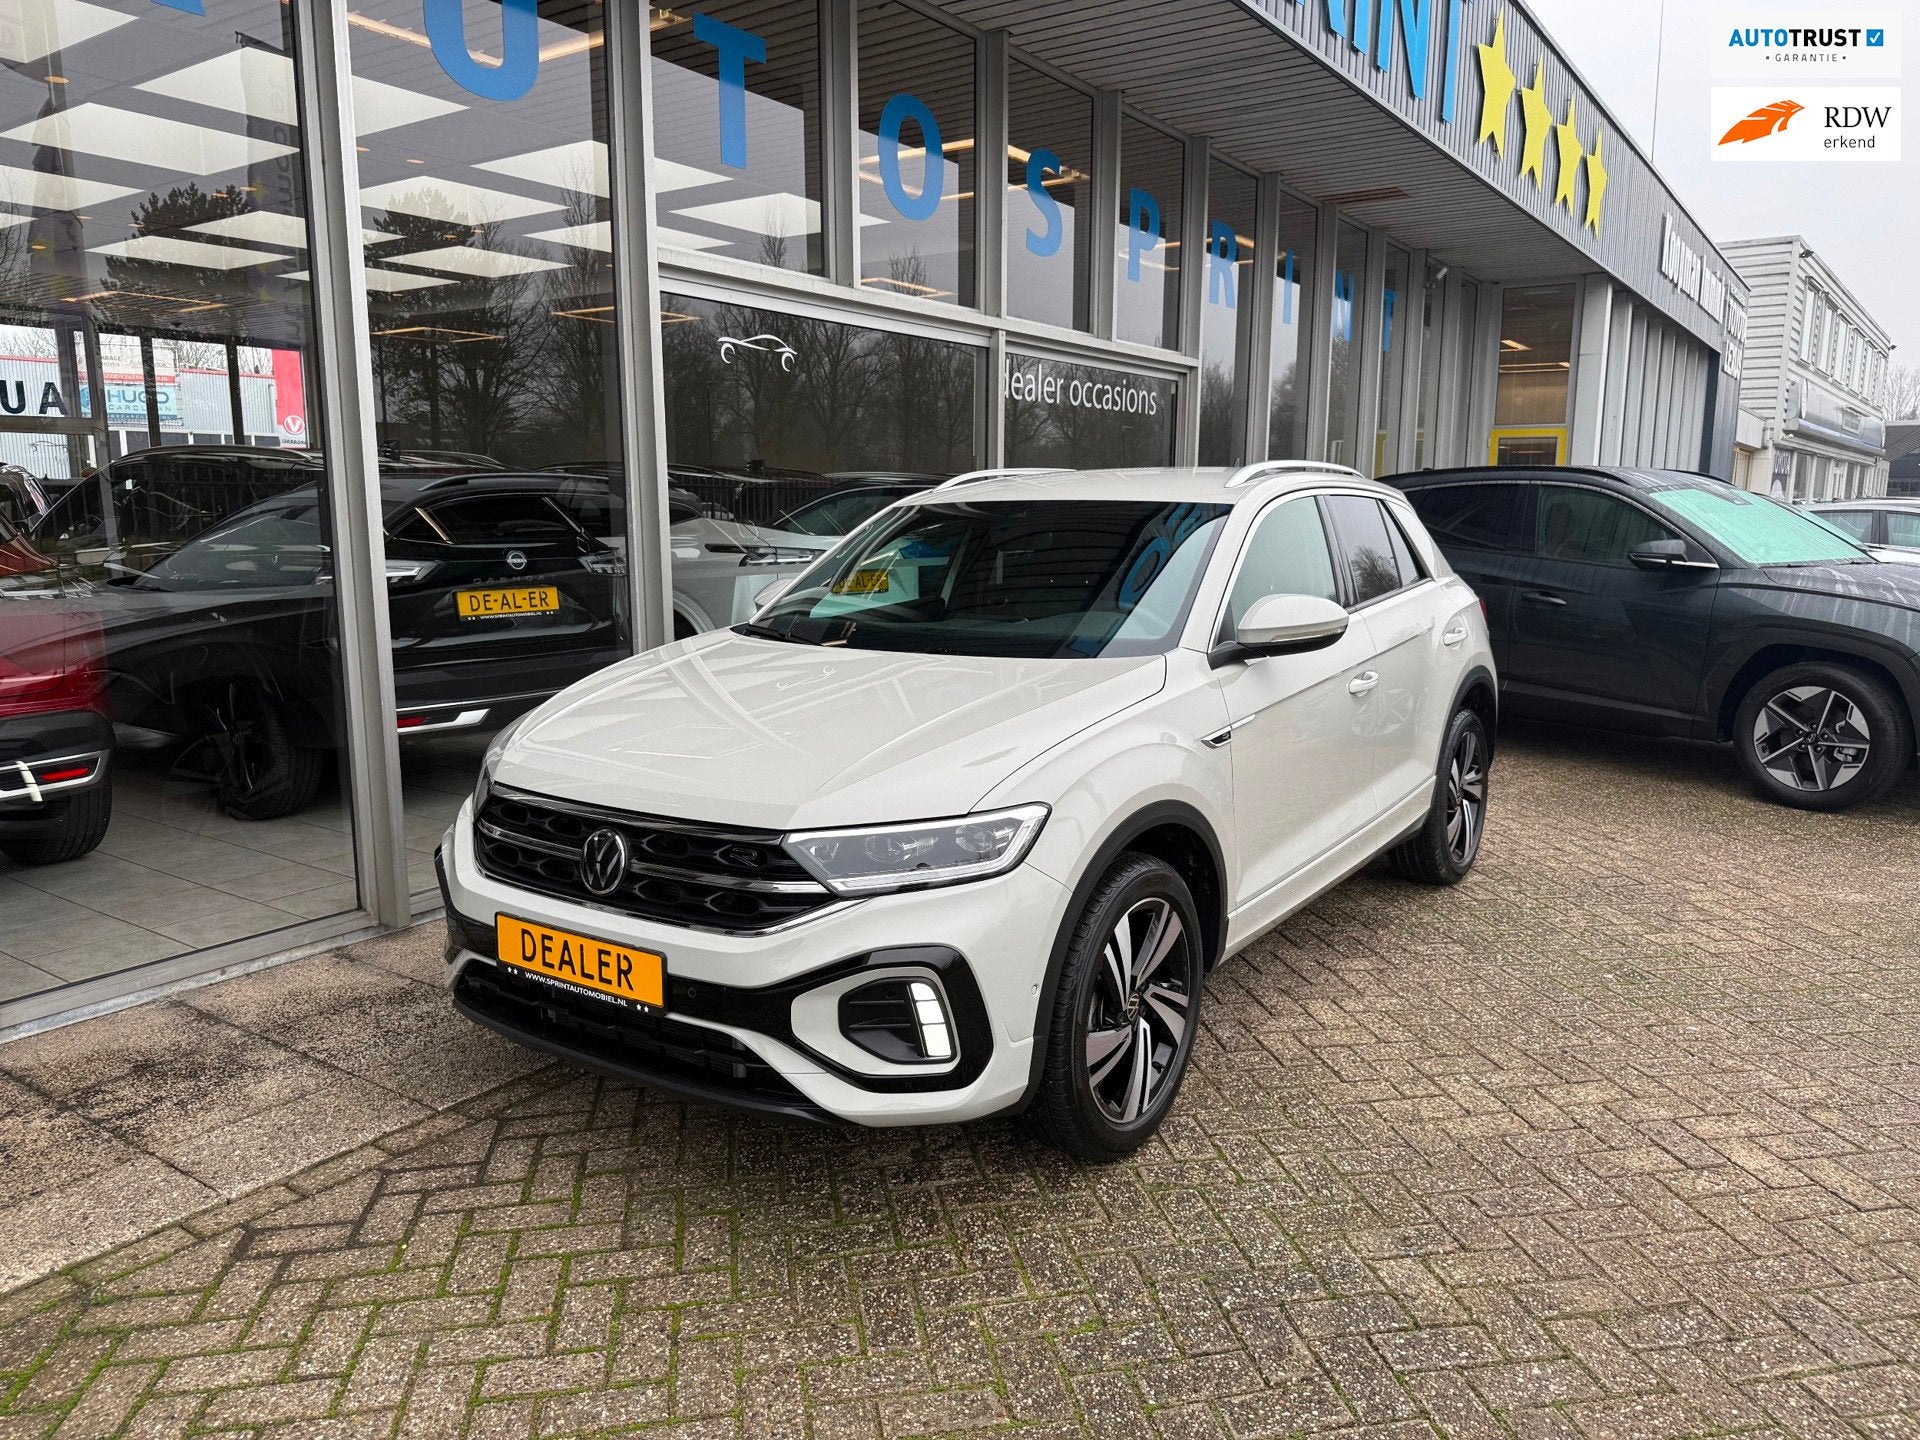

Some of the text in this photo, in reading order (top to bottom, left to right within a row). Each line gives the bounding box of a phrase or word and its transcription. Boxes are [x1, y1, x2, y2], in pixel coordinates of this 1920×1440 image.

[108, 403, 172, 412] CARCLAN
[1069, 378, 1157, 416] occasions
[469, 590, 550, 613] DE-AL-ER
[521, 928, 635, 991] DEALER
[524, 970, 629, 1007] WWW.SPRINTAUTOMOBIEL.NL
